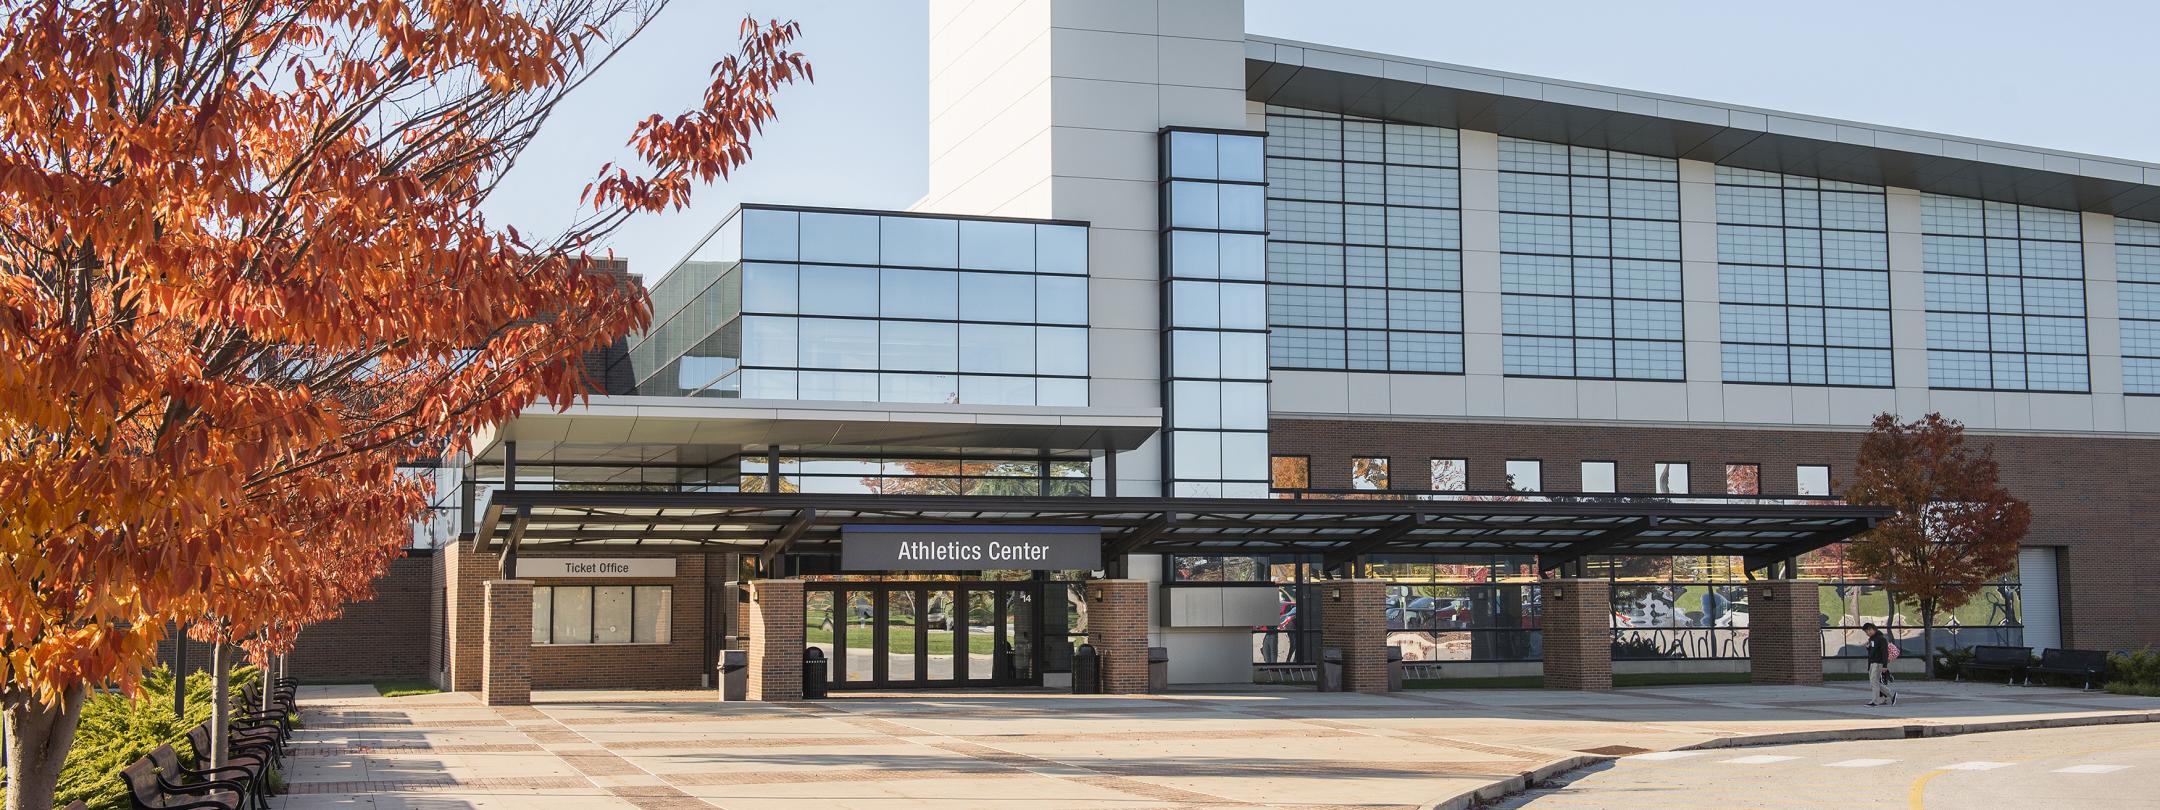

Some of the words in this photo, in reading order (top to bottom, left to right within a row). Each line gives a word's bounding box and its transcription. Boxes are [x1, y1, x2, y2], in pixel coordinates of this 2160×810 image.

[897, 541, 982, 561] Athletics
[988, 541, 1050, 561] Center
[564, 562, 597, 574] Ticket
[599, 562, 630, 574] Office
[1022, 594, 1032, 603] 14
